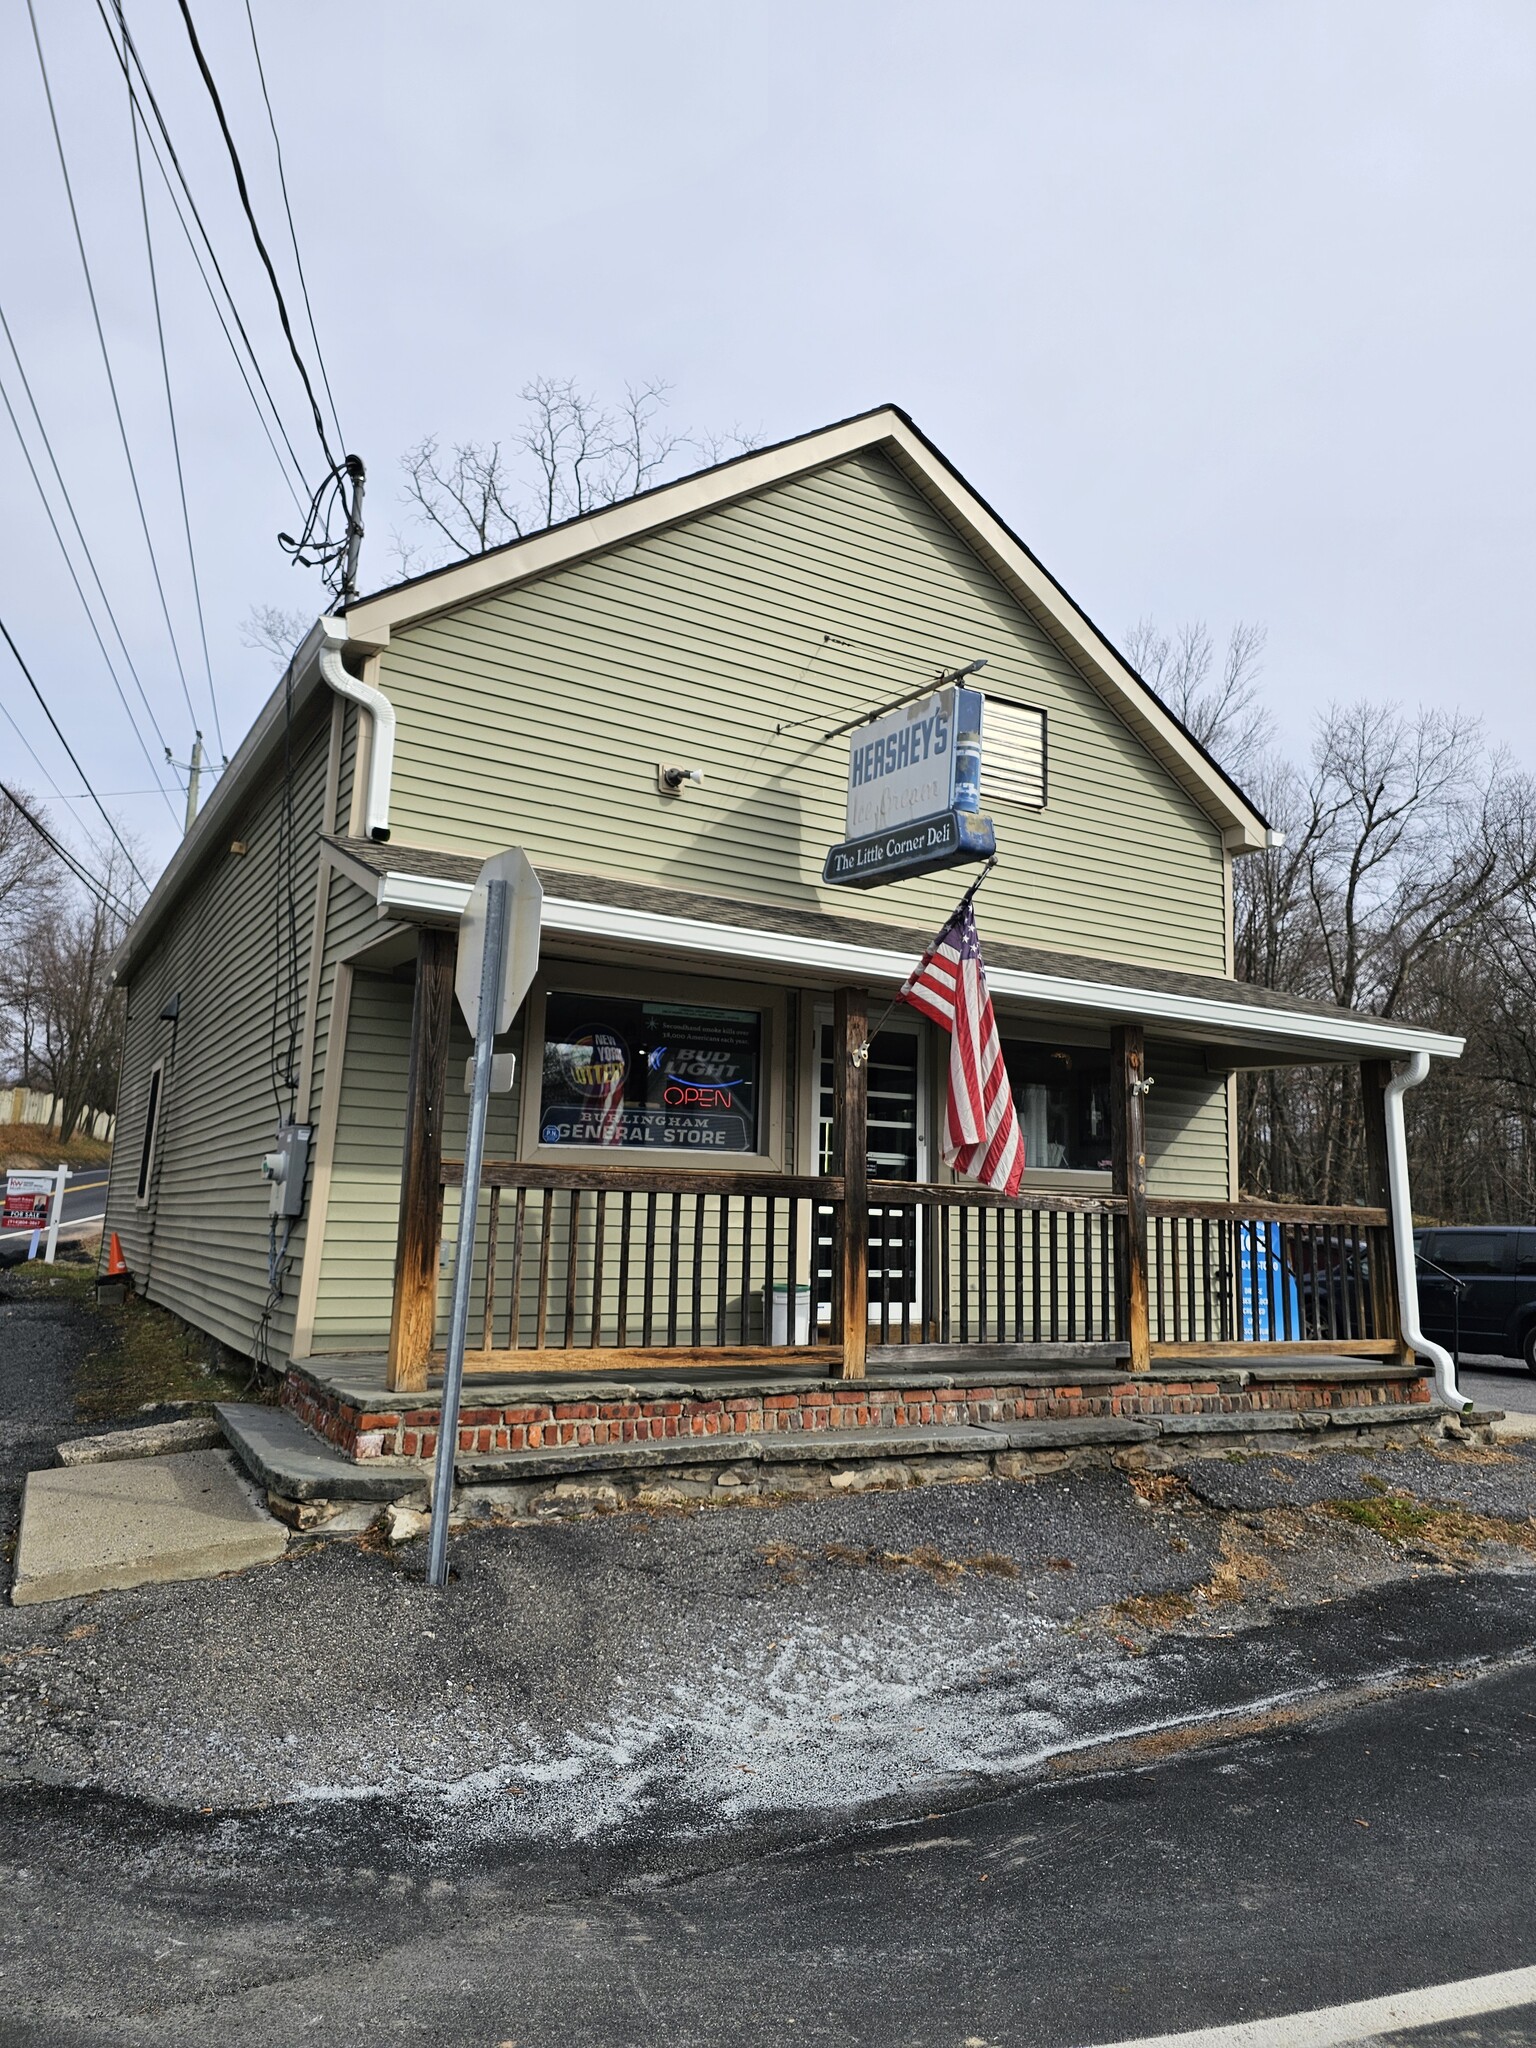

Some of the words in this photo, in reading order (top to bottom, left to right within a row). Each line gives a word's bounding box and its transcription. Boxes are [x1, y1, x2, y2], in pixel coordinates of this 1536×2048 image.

[852, 707, 948, 788] HERSHEY'S
[834, 854, 854, 871] The
[857, 845, 884, 866] Little
[886, 834, 924, 857] Corner
[927, 824, 950, 846] Deli
[595, 1035, 616, 1046] NEW
[676, 1049, 730, 1062] BUD
[664, 1061, 740, 1077] LIGHT
[663, 1086, 731, 1109] OPEN
[580, 1111, 710, 1128] BURLINGHAM
[558, 1123, 655, 1142] GENERAL
[663, 1129, 726, 1145] STORE
